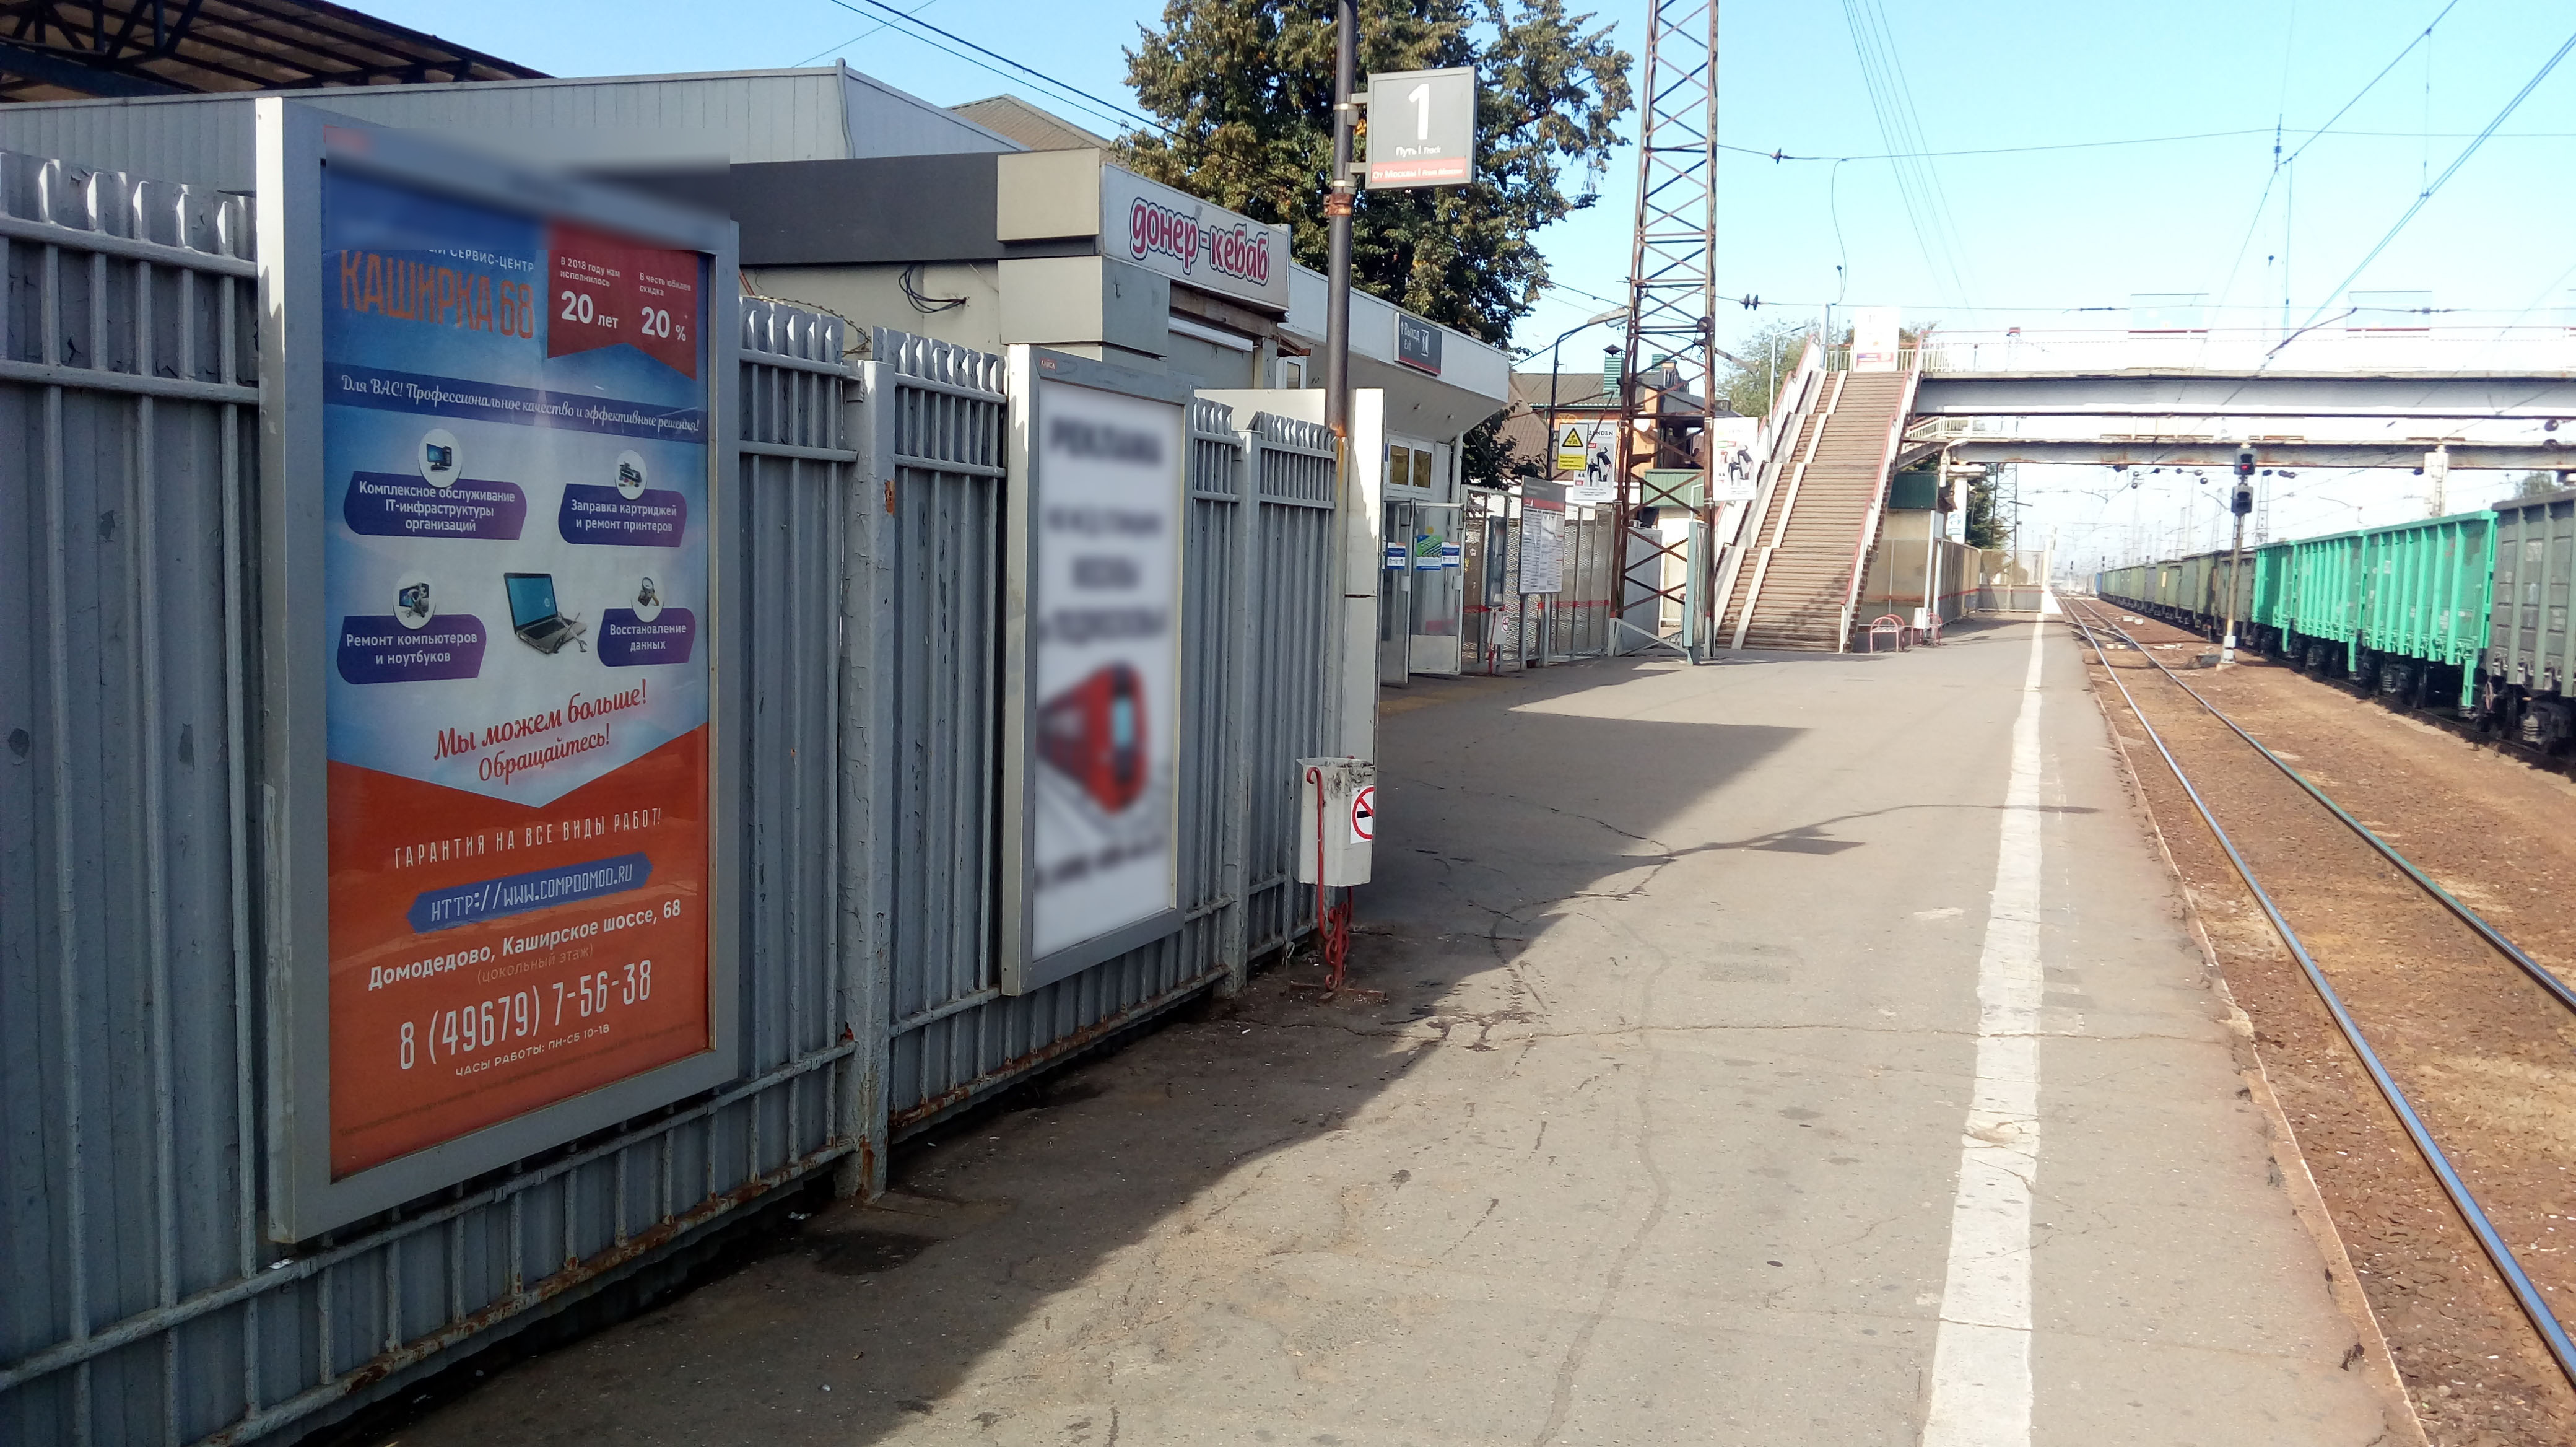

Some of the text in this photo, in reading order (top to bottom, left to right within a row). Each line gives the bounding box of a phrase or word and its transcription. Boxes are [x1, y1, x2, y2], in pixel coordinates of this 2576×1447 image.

[1408, 83, 1429, 140] 1
[1396, 146, 1417, 157] Путь
[1373, 171, 1383, 179] От
[1132, 203, 1268, 281] донер-кебаб
[450, 249, 534, 273] СЕРВИС-ЦЕНТР
[560, 256, 620, 278] В 2018 году нам
[560, 270, 611, 287] исполнилось
[639, 272, 645, 281] В
[646, 275, 666, 286] честь
[341, 249, 534, 339] КАШИРКА 68
[639, 285, 664, 296] скидка
[561, 291, 619, 329] 20 лет
[641, 307, 687, 341] 20 %
[341, 375, 367, 393] Для
[370, 378, 404, 397] ВАС!
[406, 383, 520, 411] Профессиональное
[522, 401, 574, 417] качество
[576, 409, 583, 418] и
[585, 404, 656, 426] эффективные
[359, 480, 516, 503] Комплексное обслуживание
[385, 499, 494, 518] IT-инфраструктуры
[571, 498, 677, 518] Заправка картриджей
[406, 518, 476, 532] организаций
[576, 518, 673, 533] и ремонт принтеров
[347, 633, 478, 647] Ремонт компьютеров
[610, 624, 687, 636] Восстановление
[630, 640, 666, 652] данных
[375, 650, 451, 667] и ноутбуков
[434, 678, 647, 761] Мы можем больше!
[479, 723, 610, 785] Обращайтесь!
[395, 807, 662, 869] ГАРАНТИЯ НА ВСЕ ВИДЫ РАБОТ!
[368, 899, 681, 991] Домодедово, Каширское шоссе, 68
[477, 943, 593, 985] (цокольный этаж)
[400, 960, 651, 1070] 8 (49679) 7-56-38
[455, 1023, 610, 1077] ЧАСЫ РАБОТЫ: ПН-СБ 10-18
